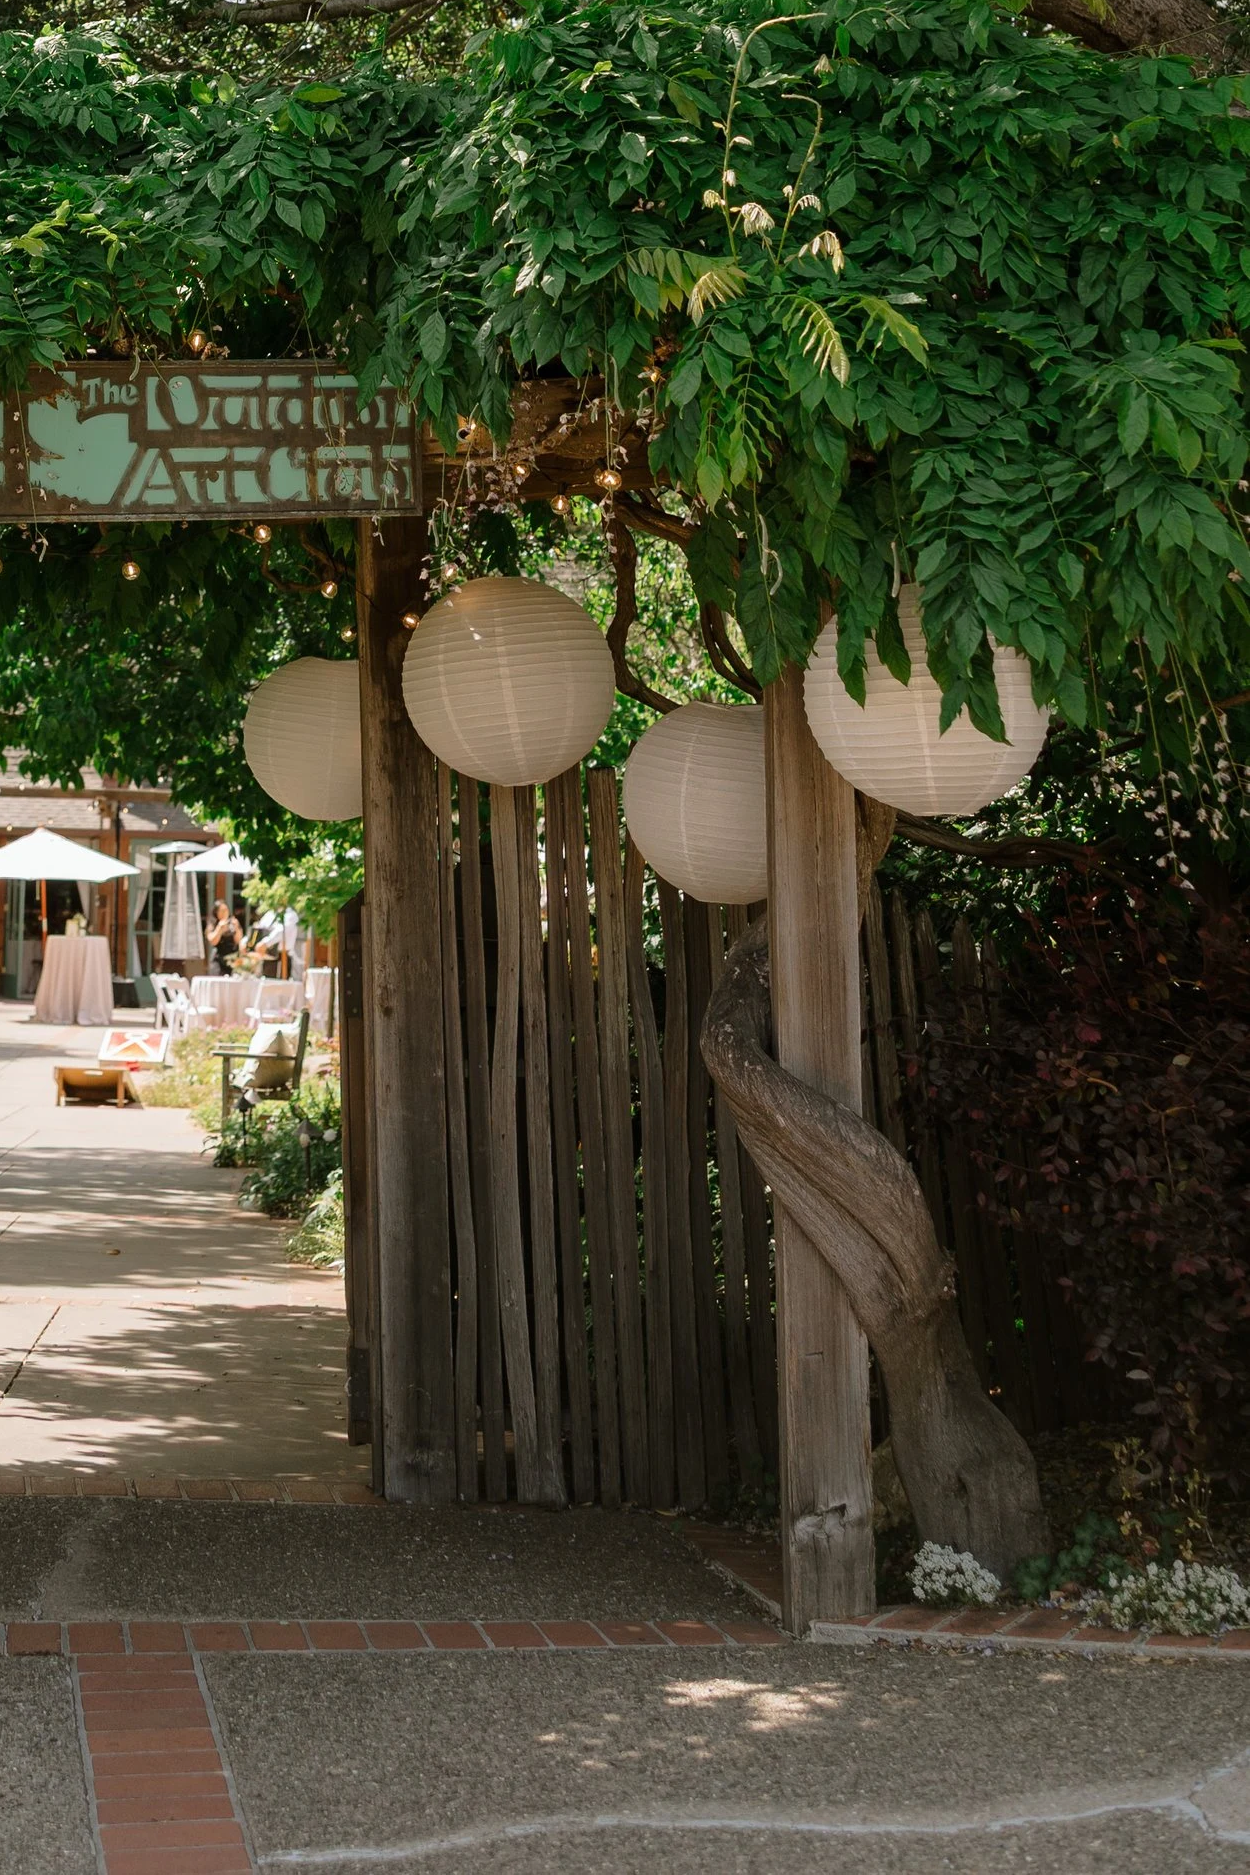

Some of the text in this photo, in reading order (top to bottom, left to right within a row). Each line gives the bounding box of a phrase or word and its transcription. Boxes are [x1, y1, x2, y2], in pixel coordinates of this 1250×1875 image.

[81, 372, 408, 431] The Outdoor
[130, 442, 409, 506] Art Club
